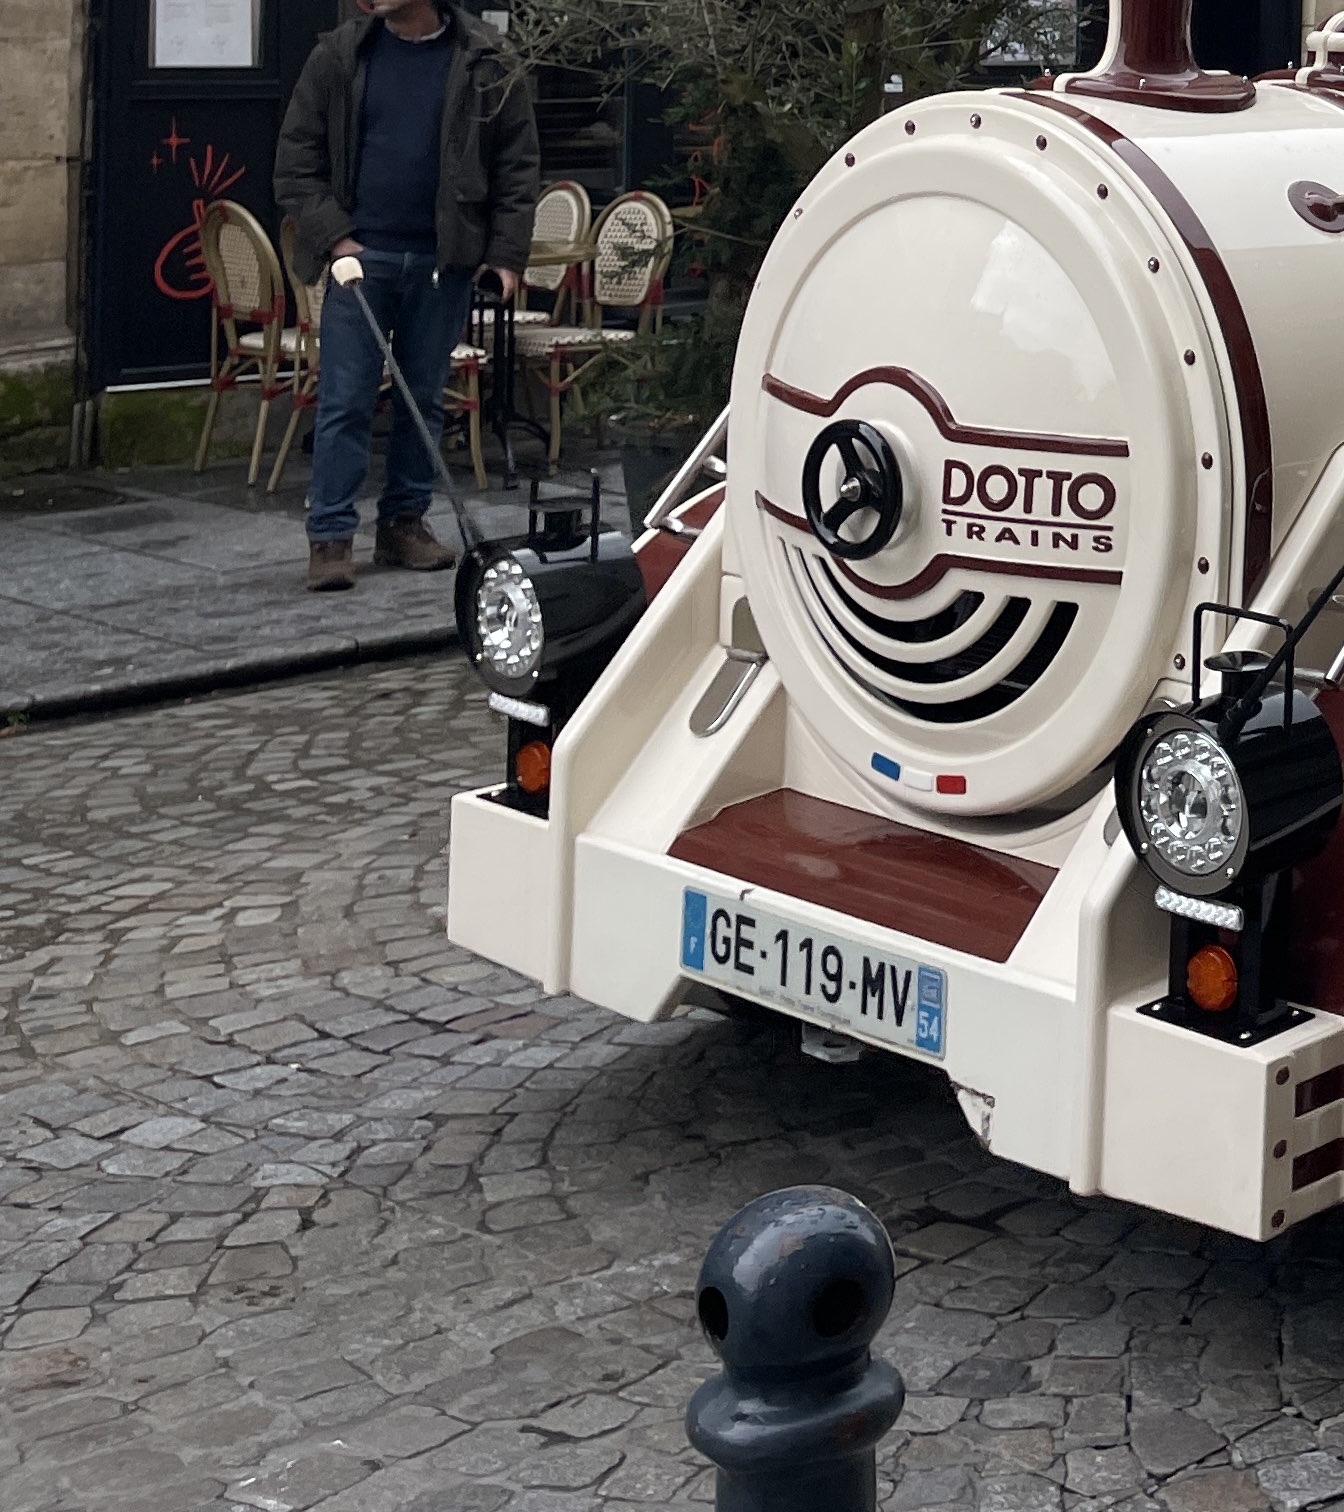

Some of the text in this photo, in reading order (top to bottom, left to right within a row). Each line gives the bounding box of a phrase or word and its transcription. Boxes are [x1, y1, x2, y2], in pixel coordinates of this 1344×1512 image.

[942, 459, 1116, 521] DOTTO
[941, 518, 1113, 553] TRAINS
[918, 1010, 939, 1043] 54
